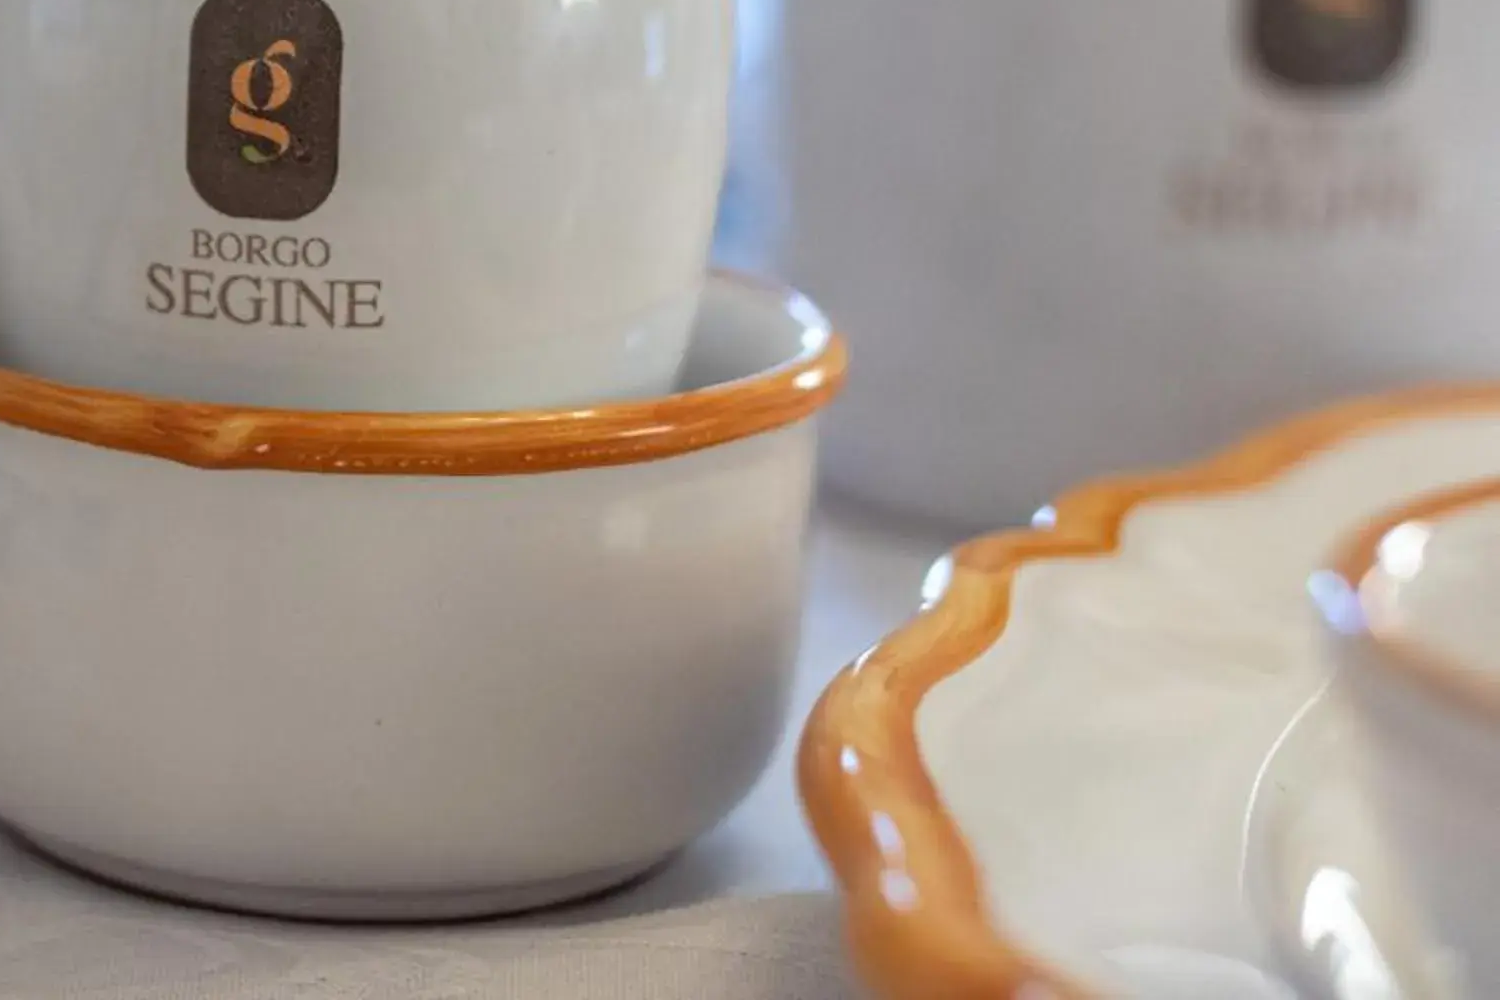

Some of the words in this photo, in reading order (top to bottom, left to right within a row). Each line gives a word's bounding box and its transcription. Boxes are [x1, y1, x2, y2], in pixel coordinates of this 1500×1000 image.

[229, 38, 296, 164] g
[191, 228, 331, 267] BORGO
[145, 263, 385, 330] SEGINE
